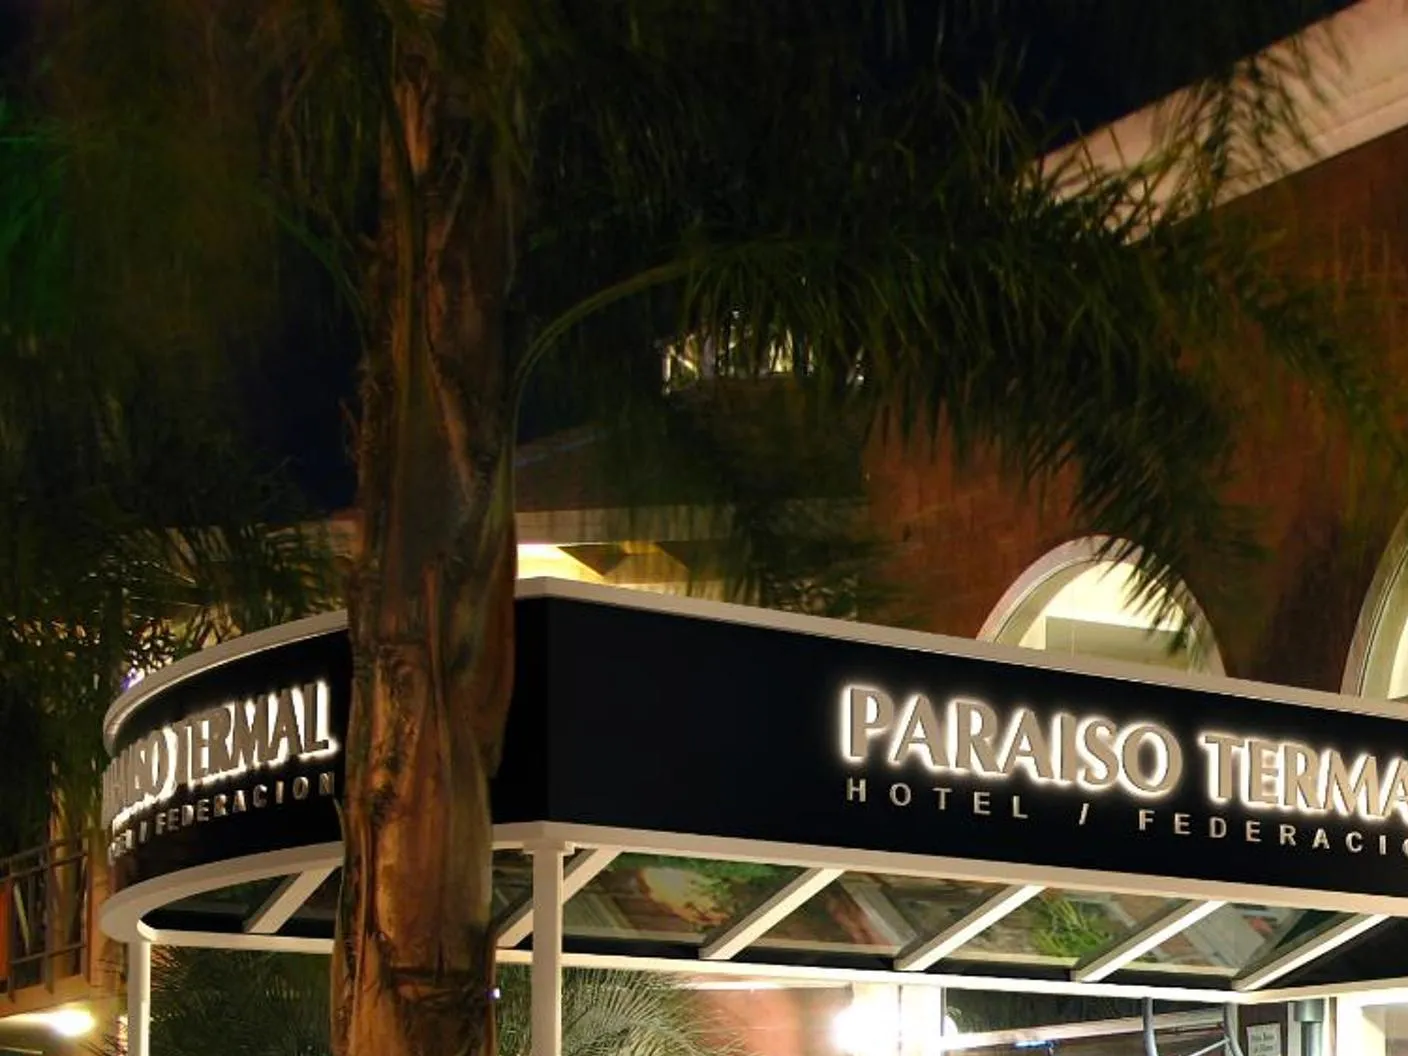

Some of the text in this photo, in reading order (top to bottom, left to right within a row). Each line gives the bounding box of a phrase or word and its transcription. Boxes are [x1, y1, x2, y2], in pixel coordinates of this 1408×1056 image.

[172, 682, 334, 790] TERMAL
[844, 685, 1183, 797] PARAISO
[156, 772, 335, 835] FEDERACION
[845, 777, 1029, 820] HOTEL
